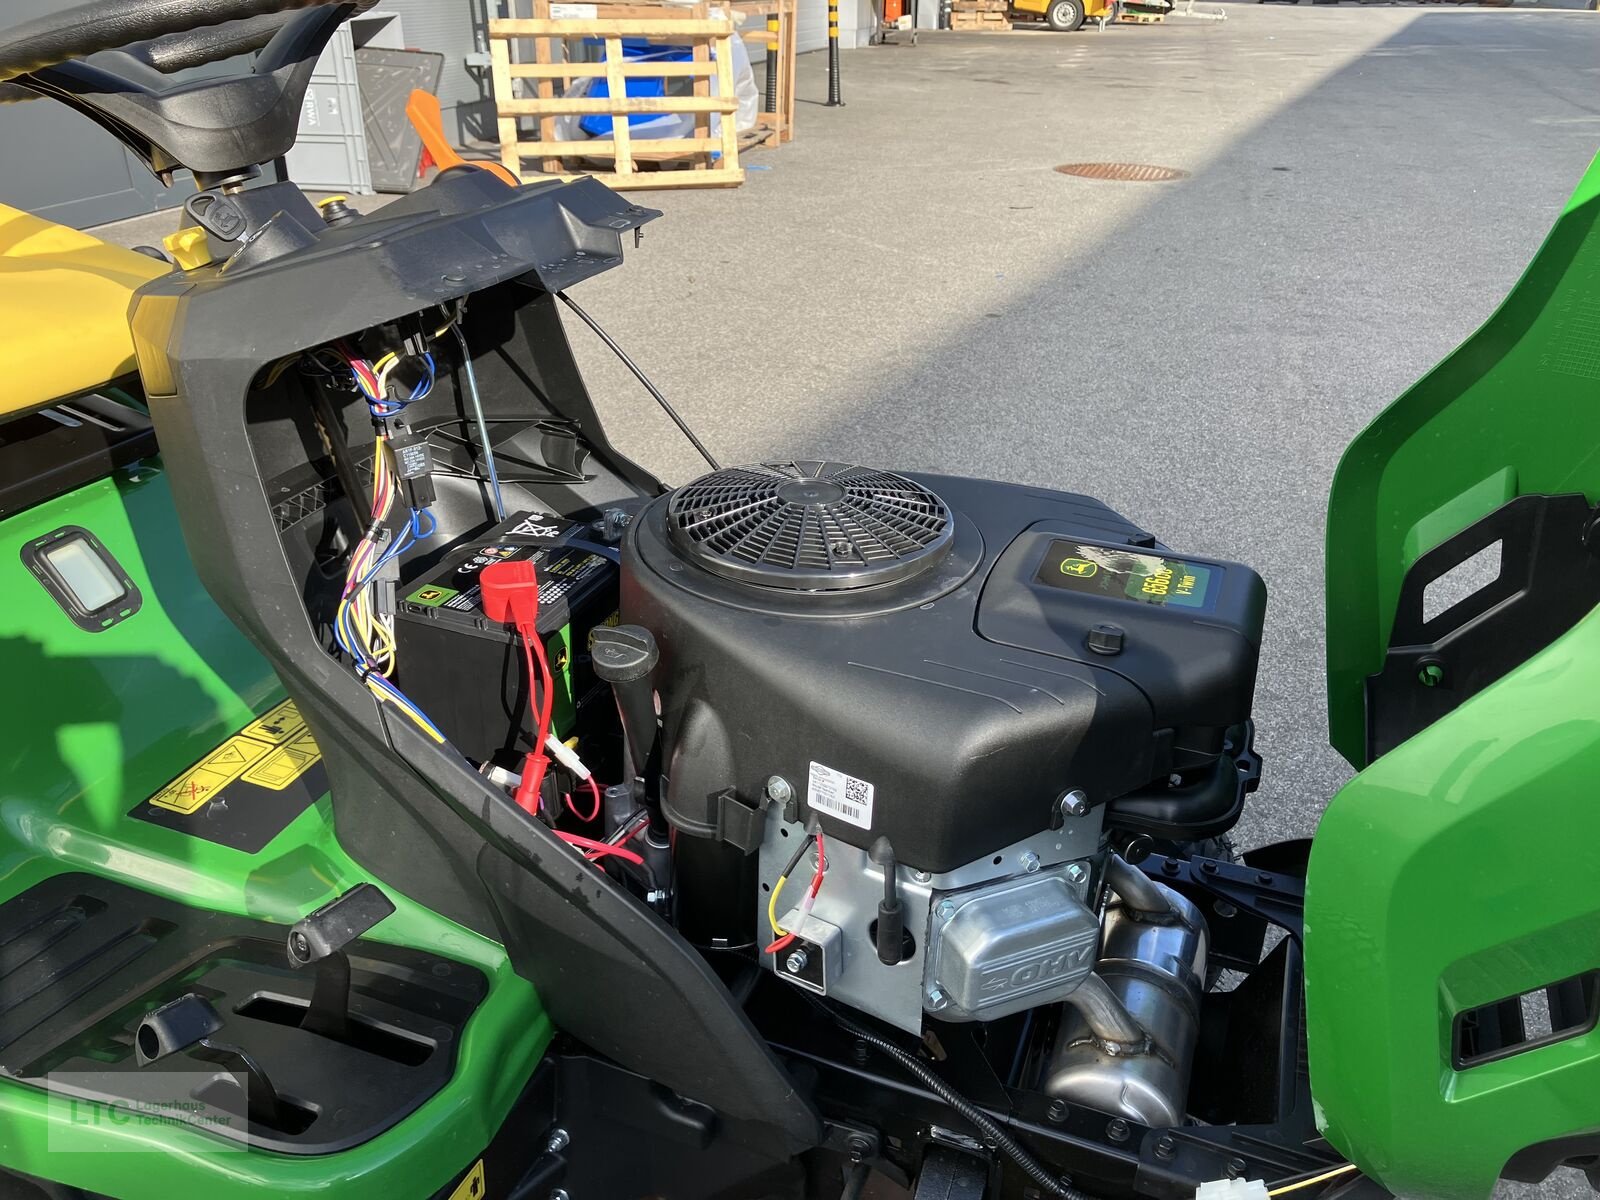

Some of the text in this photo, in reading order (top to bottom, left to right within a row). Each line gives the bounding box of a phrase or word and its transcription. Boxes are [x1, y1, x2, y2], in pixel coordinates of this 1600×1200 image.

[457, 563, 479, 574] CE
[1142, 567, 1173, 595] 656cc
[1176, 575, 1196, 595] V-Twin
[1010, 945, 1094, 988] OHV
